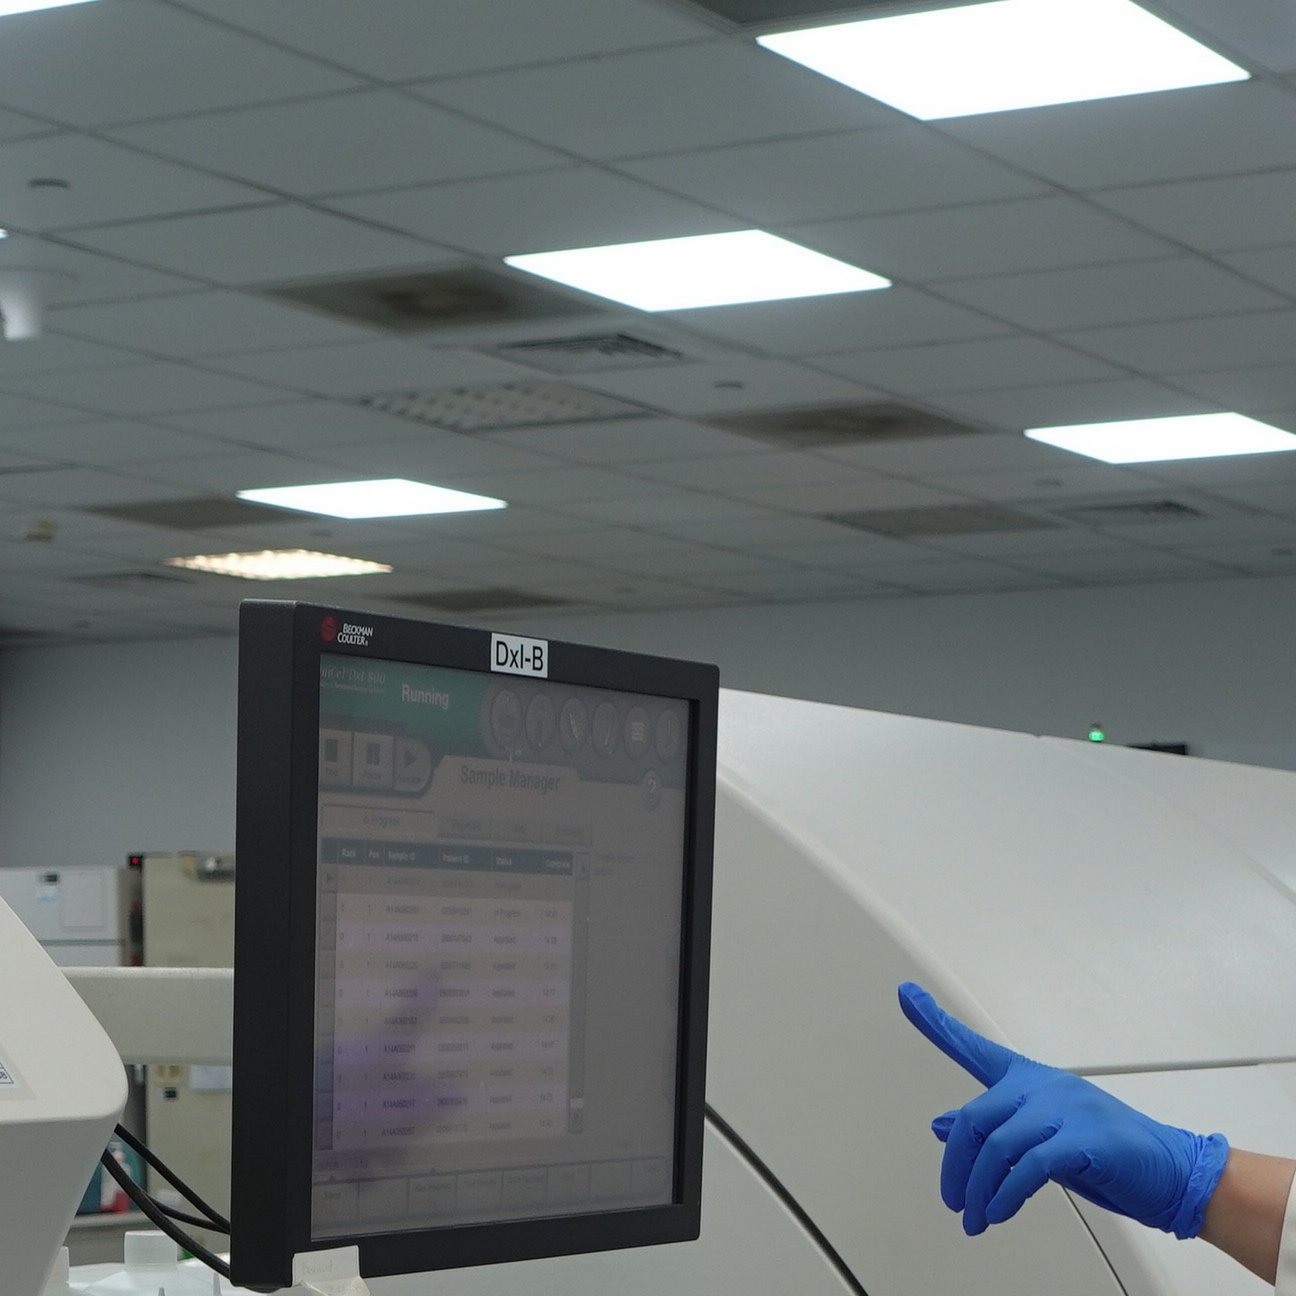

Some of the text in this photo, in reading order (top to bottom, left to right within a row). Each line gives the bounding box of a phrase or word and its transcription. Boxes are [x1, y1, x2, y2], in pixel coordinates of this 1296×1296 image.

[337, 632, 366, 646] COULTER
[342, 623, 374, 637] BECKMAN
[401, 683, 450, 710] Running
[460, 764, 560, 795] Sample Manager
